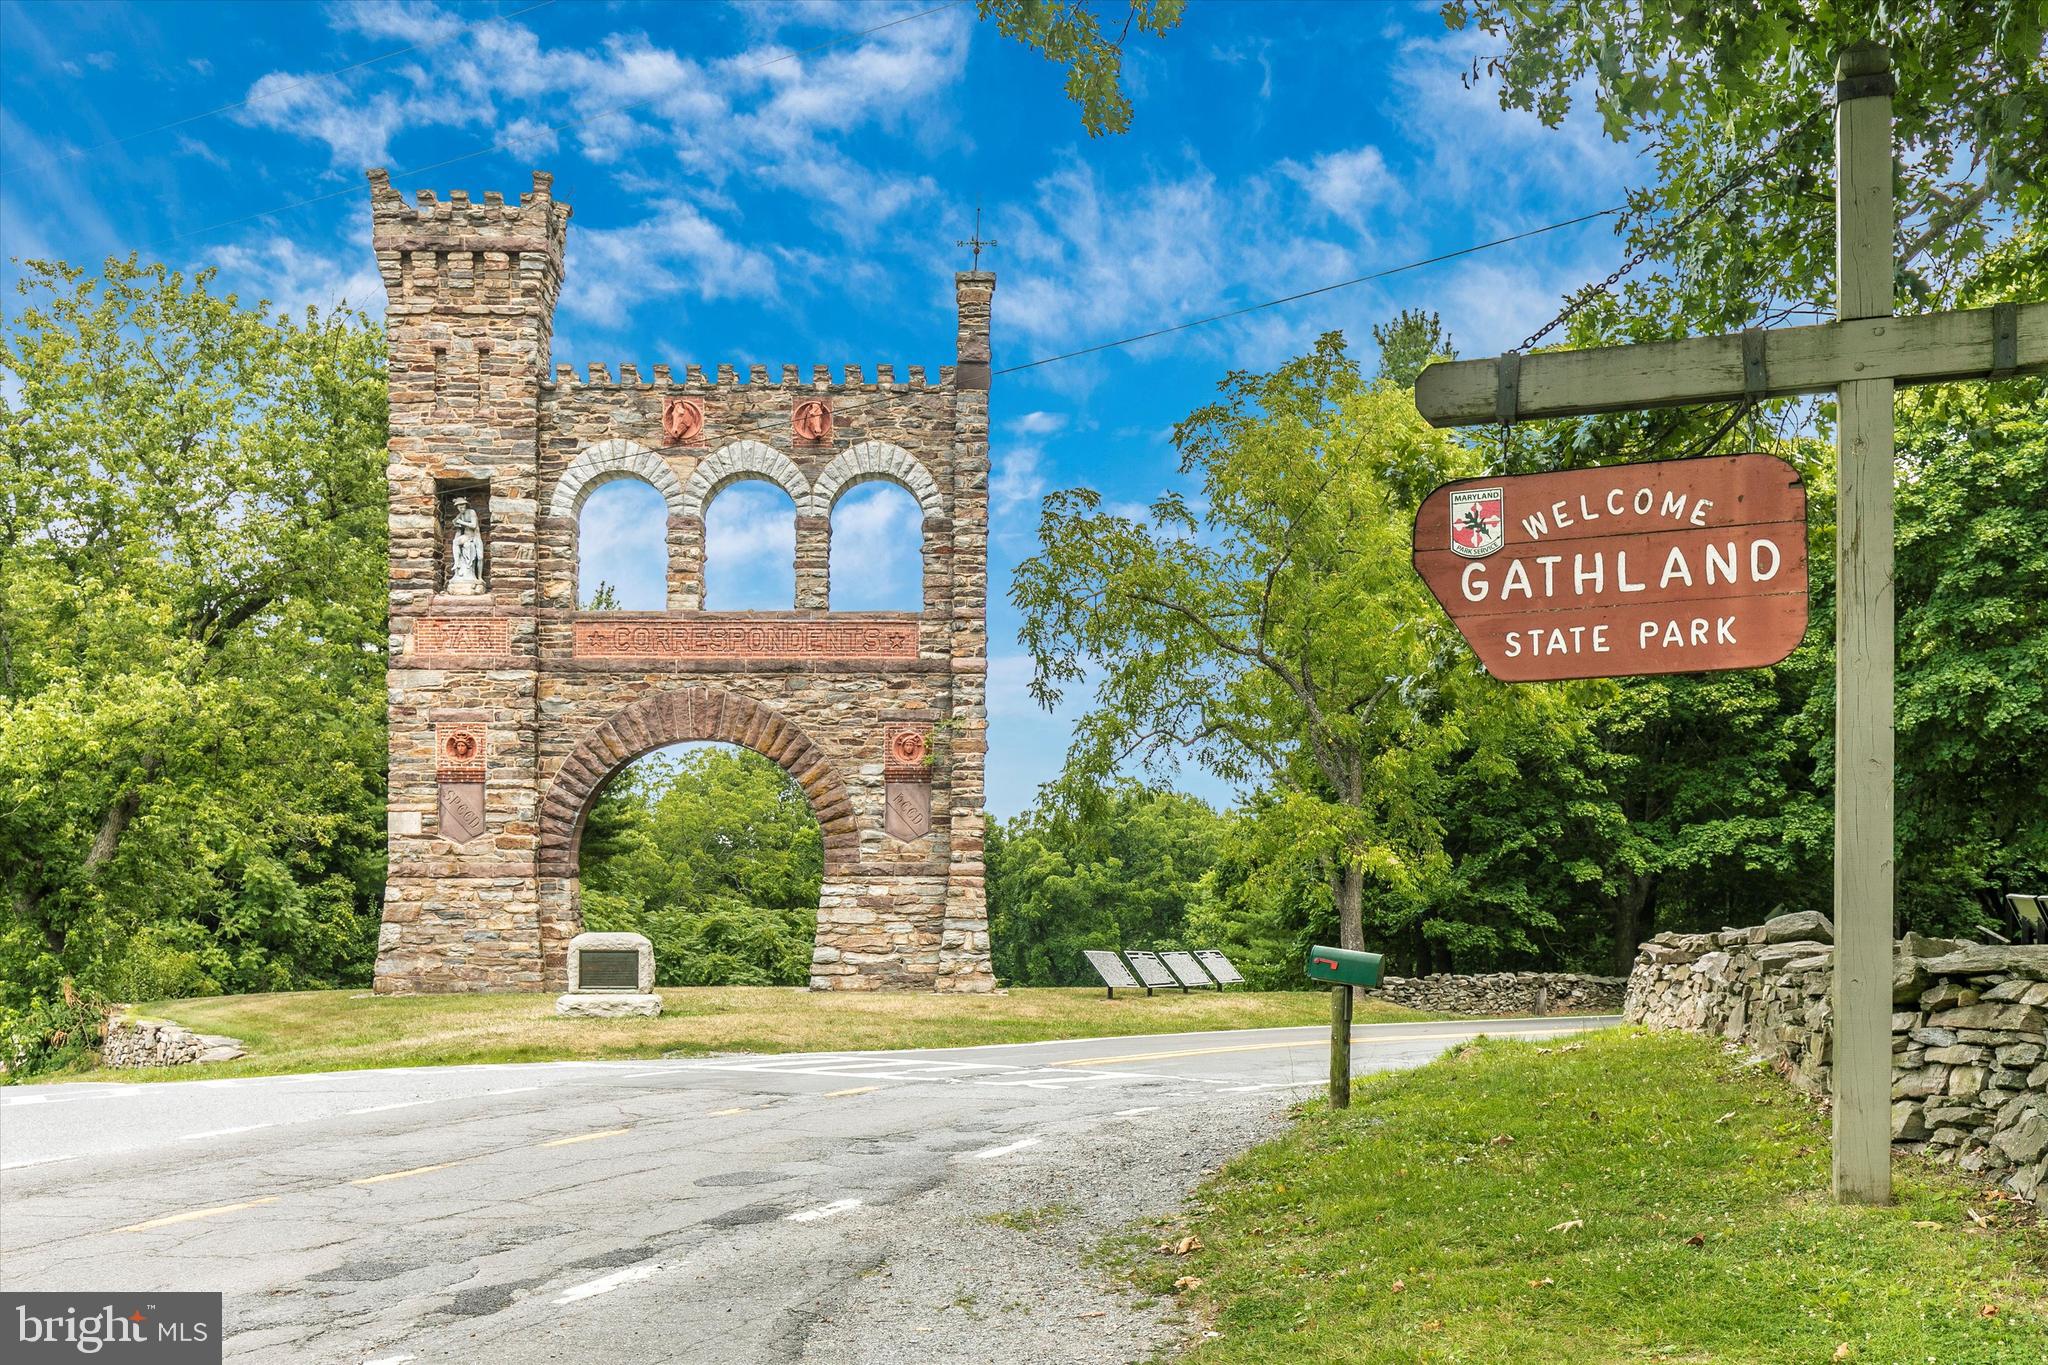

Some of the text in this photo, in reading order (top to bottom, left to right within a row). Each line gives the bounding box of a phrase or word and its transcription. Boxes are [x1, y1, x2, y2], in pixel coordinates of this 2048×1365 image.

[1454, 491, 1499, 502] MARYLAND
[1521, 487, 1714, 541] WELCOME
[1456, 541, 1499, 555] PARK SERVICE
[1461, 538, 1781, 602] GATHLAND
[433, 624, 495, 649] WAR
[614, 627, 881, 652] CORRESPONDENTS
[1504, 615, 1737, 658] STATE PARK
